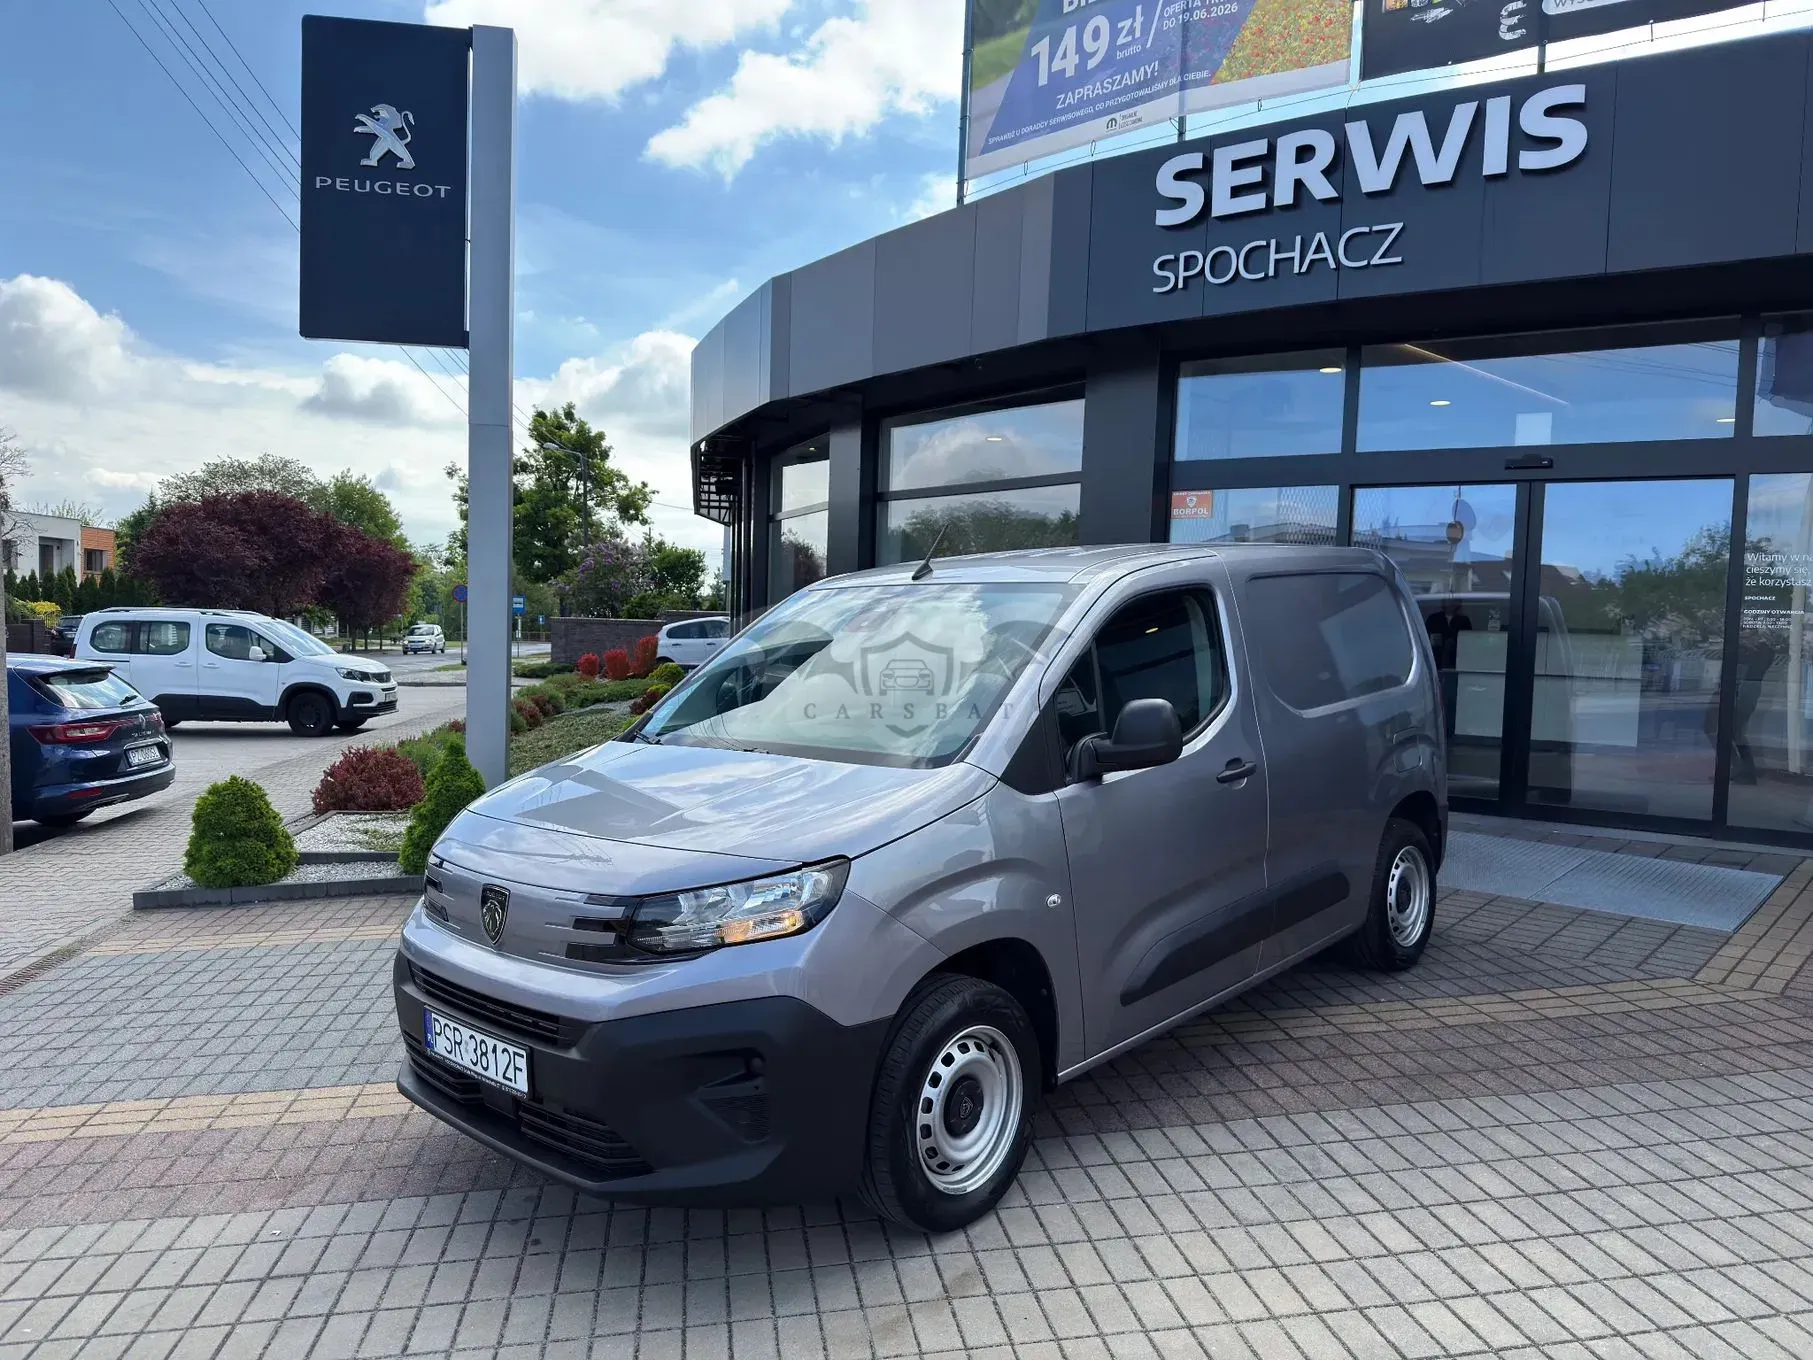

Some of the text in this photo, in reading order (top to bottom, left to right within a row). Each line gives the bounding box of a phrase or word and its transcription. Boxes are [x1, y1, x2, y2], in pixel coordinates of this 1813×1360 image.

[1163, 0, 1201, 17] OFERTA
[1163, 2, 1238, 31] DO 19.06.2026
[1030, 5, 1144, 87] 149 zł
[1116, 43, 1142, 60] brutto
[1055, 61, 1159, 110] ZAPRASZAMY!
[1021, 120, 1048, 135] DORADCY
[1095, 102, 1105, 111] CO
[1105, 81, 1168, 109] PRZYGOTOWALIŚMY
[1168, 75, 1183, 86] DLA
[1183, 70, 1211, 81] CIEBIE.
[1155, 84, 1588, 226] SERWIS
[315, 176, 452, 198] PEUGEOT
[1152, 222, 1404, 293] SPOCHACZ
[1173, 507, 1209, 515] BORPOL
[1745, 564, 1792, 576] cieszymy
[1746, 552, 1788, 563] Witamy
[1745, 576, 1812, 588] że korzystasz
[433, 1017, 464, 1061] PSR
[468, 1034, 525, 1085] 3812F
